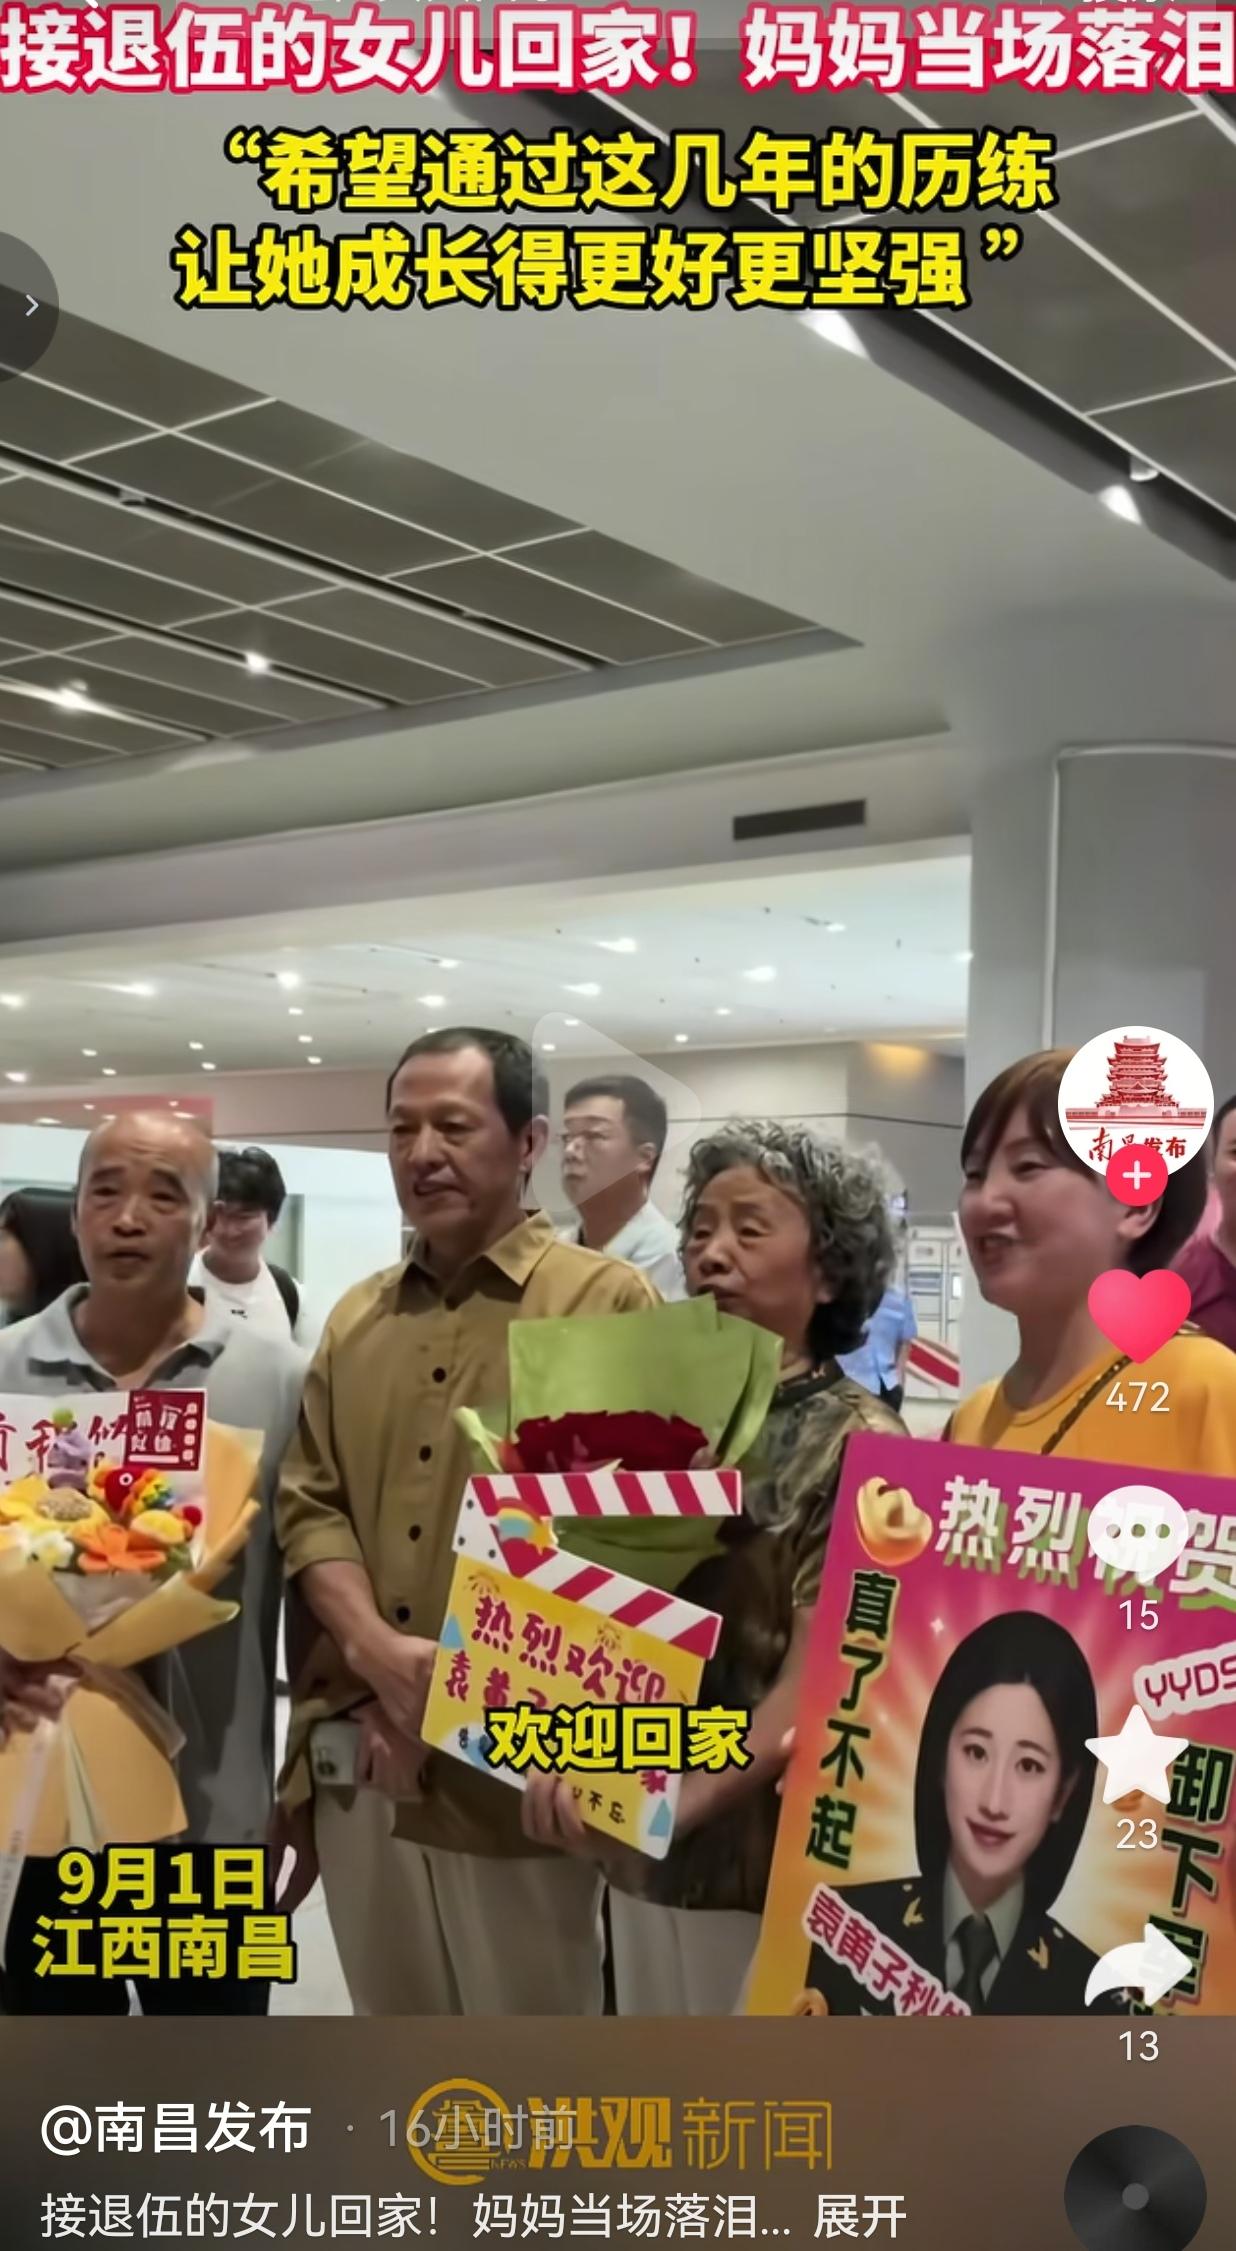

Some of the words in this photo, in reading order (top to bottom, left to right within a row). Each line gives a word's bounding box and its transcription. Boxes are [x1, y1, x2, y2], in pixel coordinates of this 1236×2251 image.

[471, 1595, 667, 1703] 热烈欢迎
[1145, 1656, 1236, 1707] YYDS
[805, 1572, 898, 1870] 真了不起
[807, 1889, 965, 2014] 袁黄子秋
